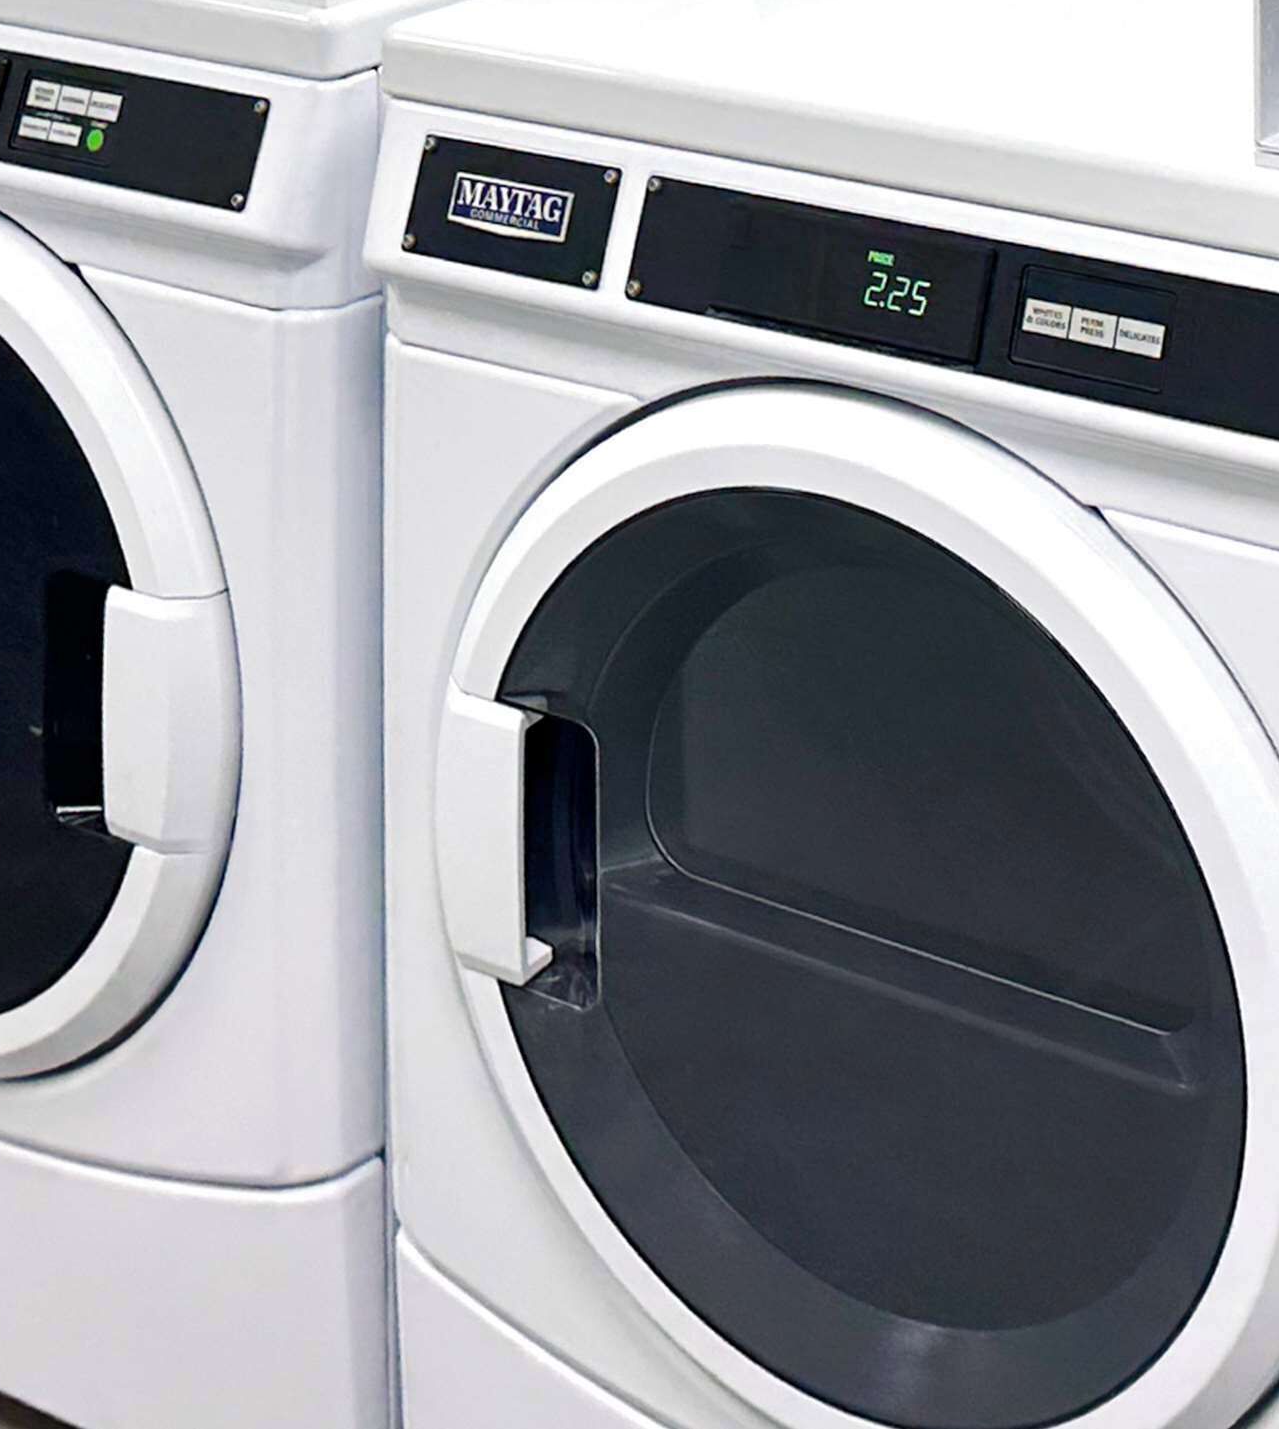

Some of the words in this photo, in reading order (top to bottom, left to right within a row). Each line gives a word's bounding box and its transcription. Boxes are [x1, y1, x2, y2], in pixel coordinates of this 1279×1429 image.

[458, 179, 563, 222] MAYTAG
[470, 207, 540, 231] COMMERCIAL
[864, 271, 931, 316] 2.25
